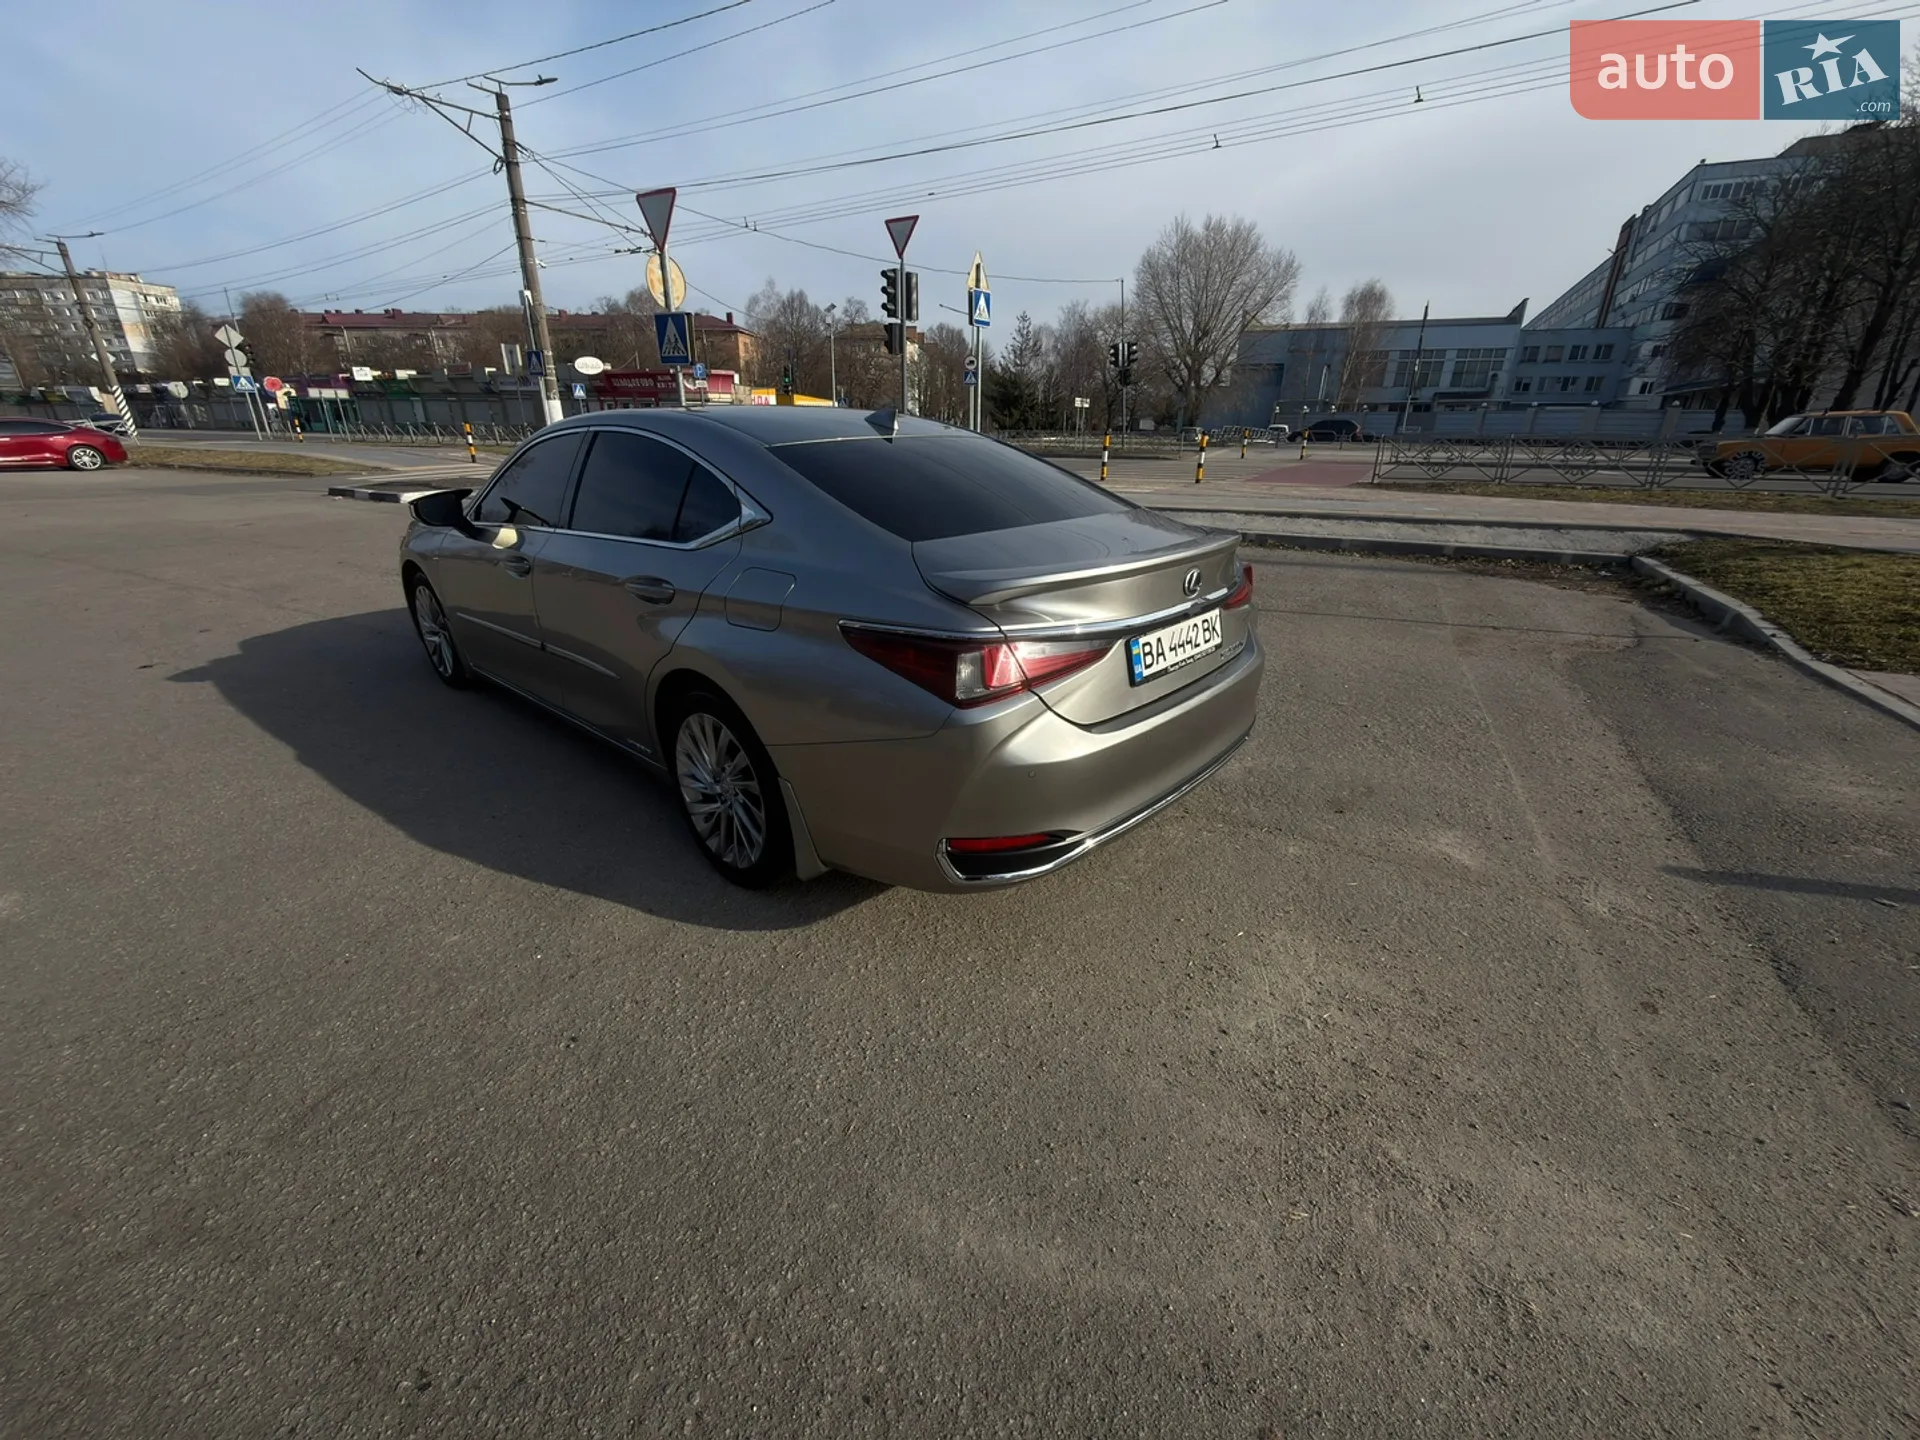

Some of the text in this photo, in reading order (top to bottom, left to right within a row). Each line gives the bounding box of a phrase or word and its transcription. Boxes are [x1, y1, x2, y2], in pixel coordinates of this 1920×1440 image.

[1142, 637, 1166, 670] BA
[1169, 623, 1201, 657] 4442
[1202, 615, 1219, 644] BK
